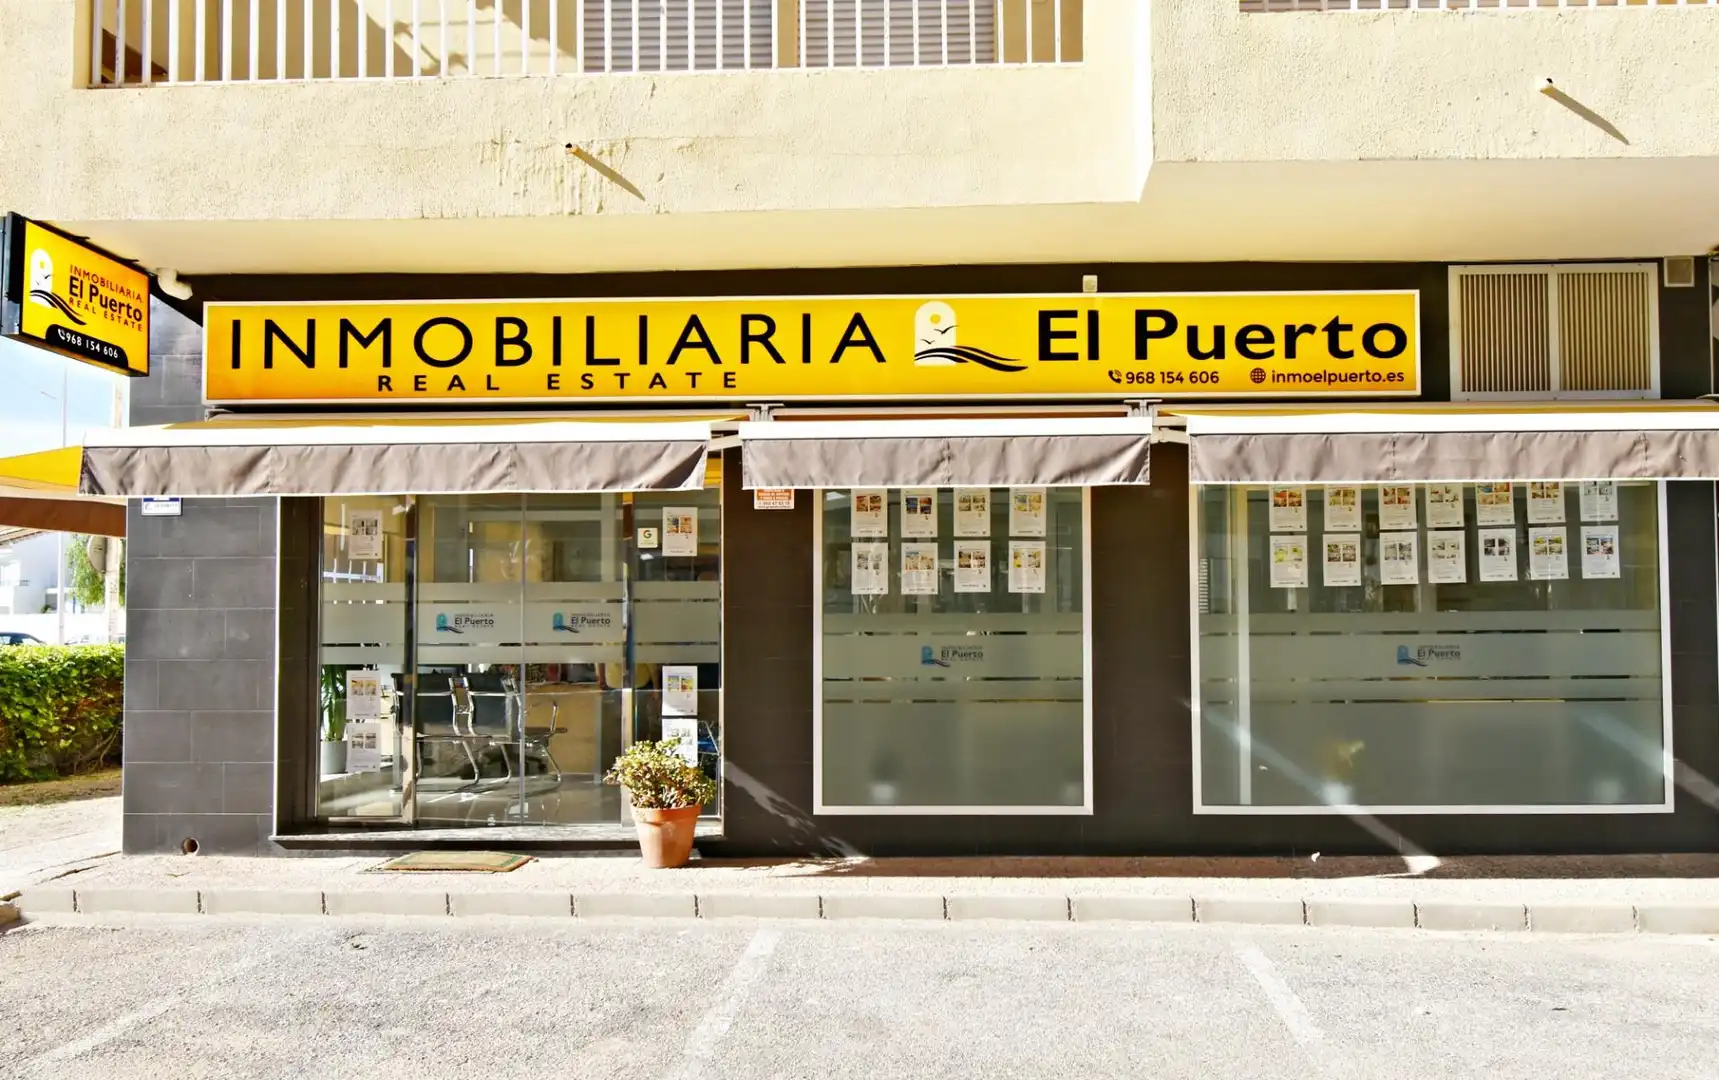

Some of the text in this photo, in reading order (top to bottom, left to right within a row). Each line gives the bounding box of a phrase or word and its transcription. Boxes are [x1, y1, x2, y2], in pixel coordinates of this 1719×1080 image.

[70, 264, 142, 303] INMOBILIARIA
[69, 276, 142, 322] El Puerto
[69, 297, 142, 332] REAL ESTATE
[66, 332, 119, 359] 968 154 606
[231, 312, 887, 369] INMOBILIARIA
[1038, 309, 1408, 361] El Puerto
[378, 371, 737, 392] REAL ESTATE
[1125, 370, 1219, 385] 968 154 606
[1271, 369, 1404, 385] inmoelpuerto.es
[455, 617, 494, 625] El Puerto
[571, 616, 611, 624] El Puerto
[941, 649, 984, 658] El Puerto
[1428, 648, 1461, 657] Puerto
